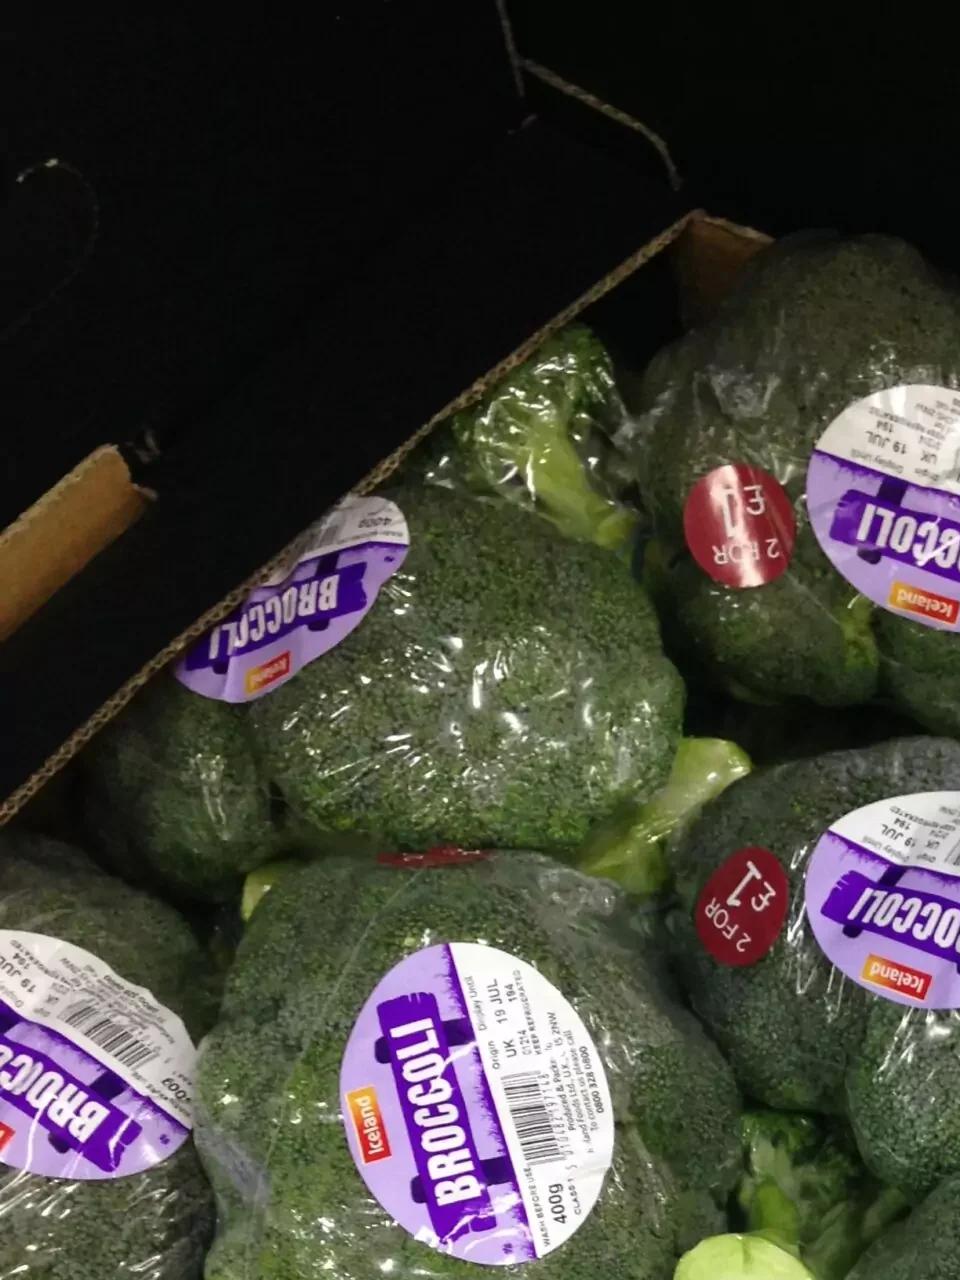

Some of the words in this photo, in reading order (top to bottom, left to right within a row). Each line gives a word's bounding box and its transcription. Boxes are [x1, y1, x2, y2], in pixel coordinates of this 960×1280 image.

[865, 430, 891, 447] JUL
[893, 441, 906, 455] 19
[765, 538, 779, 557] 2
[897, 589, 953, 617] Iceland
[882, 824, 904, 840] JUL
[726, 861, 775, 912] £1
[705, 898, 739, 940] FOR
[736, 932, 751, 952] 2
[21, 978, 36, 993] 19
[870, 962, 924, 993] Iceland
[487, 979, 503, 1005] JUL
[504, 984, 517, 1002] 194
[494, 1009, 508, 1024] 19
[487, 1040, 501, 1070] Origin
[503, 1039, 517, 1058] UK
[586, 1071, 598, 1088] 328
[390, 1018, 482, 1206] BROCCOLI
[558, 1094, 575, 1131] Produced
[591, 1090, 604, 1114] 0800
[355, 1096, 384, 1154] Iceland
[547, 1183, 567, 1224] 400g
